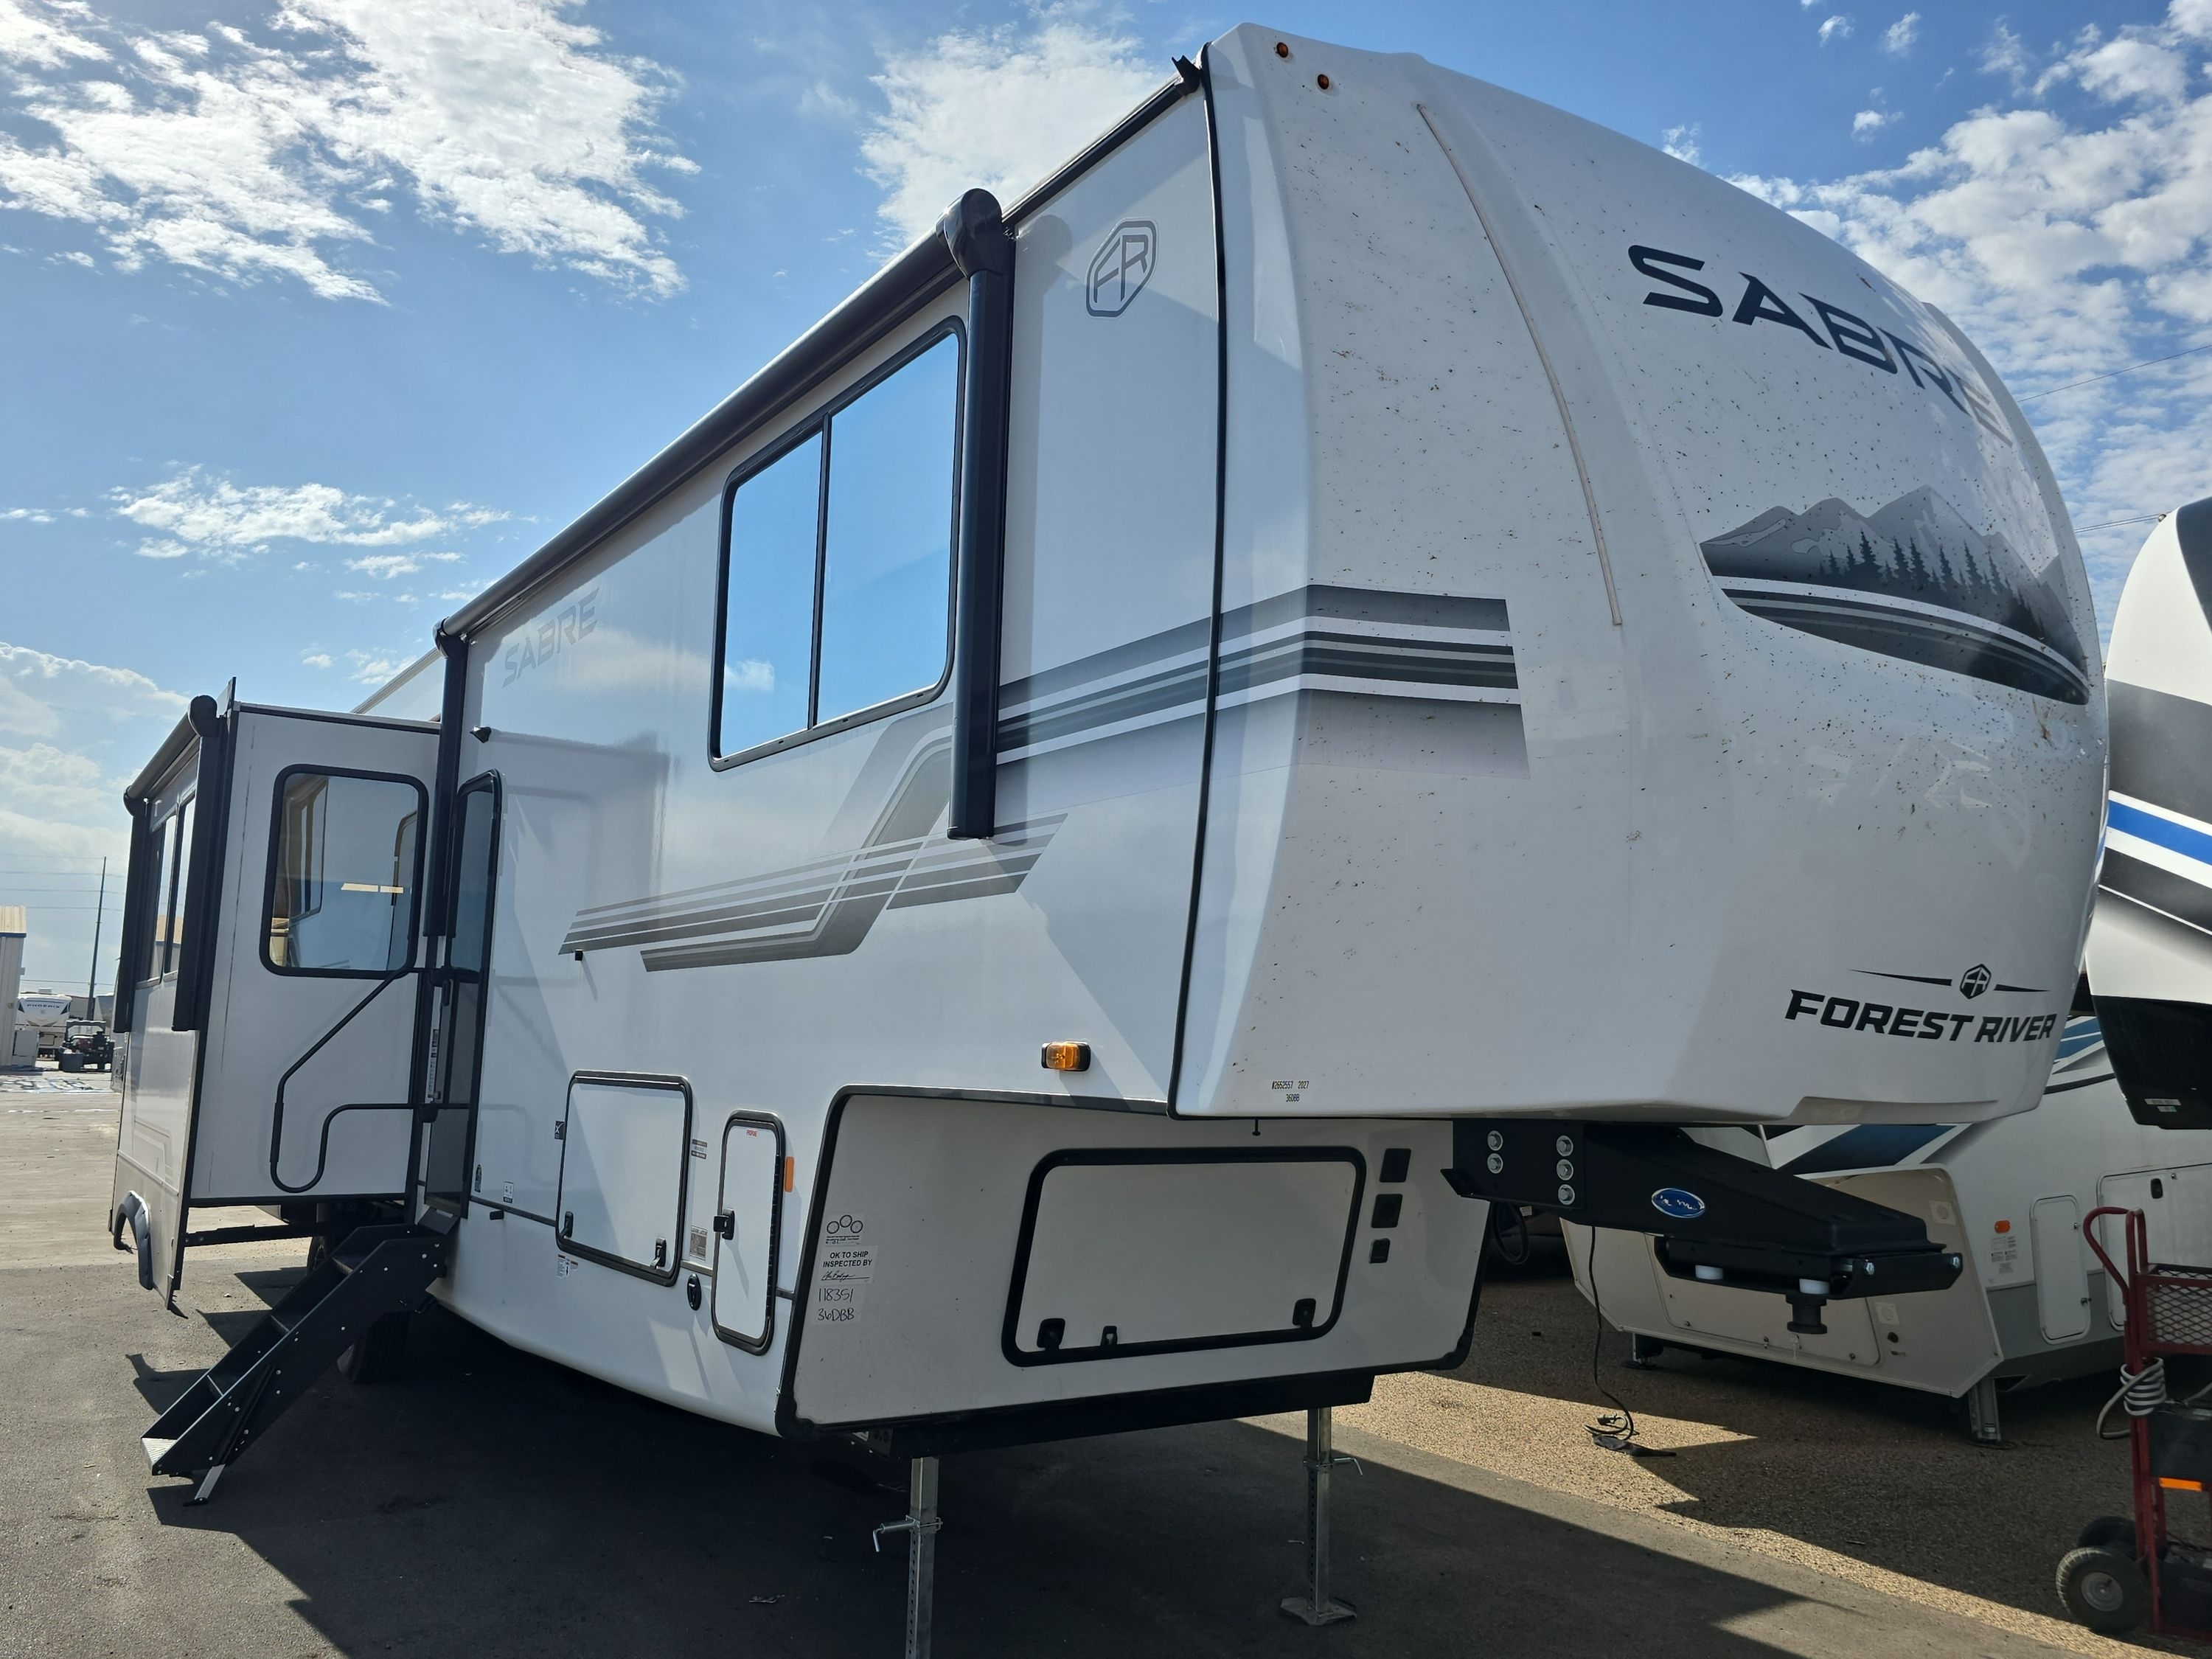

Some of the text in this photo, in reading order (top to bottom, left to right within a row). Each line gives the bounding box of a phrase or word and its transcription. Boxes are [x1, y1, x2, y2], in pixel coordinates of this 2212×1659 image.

[1627, 244, 2014, 448] SABRE
[501, 588, 600, 689] SABRE
[1784, 989, 2057, 1043] FOREST RIVER
[863, 1259, 873, 1267] BY
[818, 1288, 854, 1303] 118351
[817, 1307, 855, 1321] 36DBB
